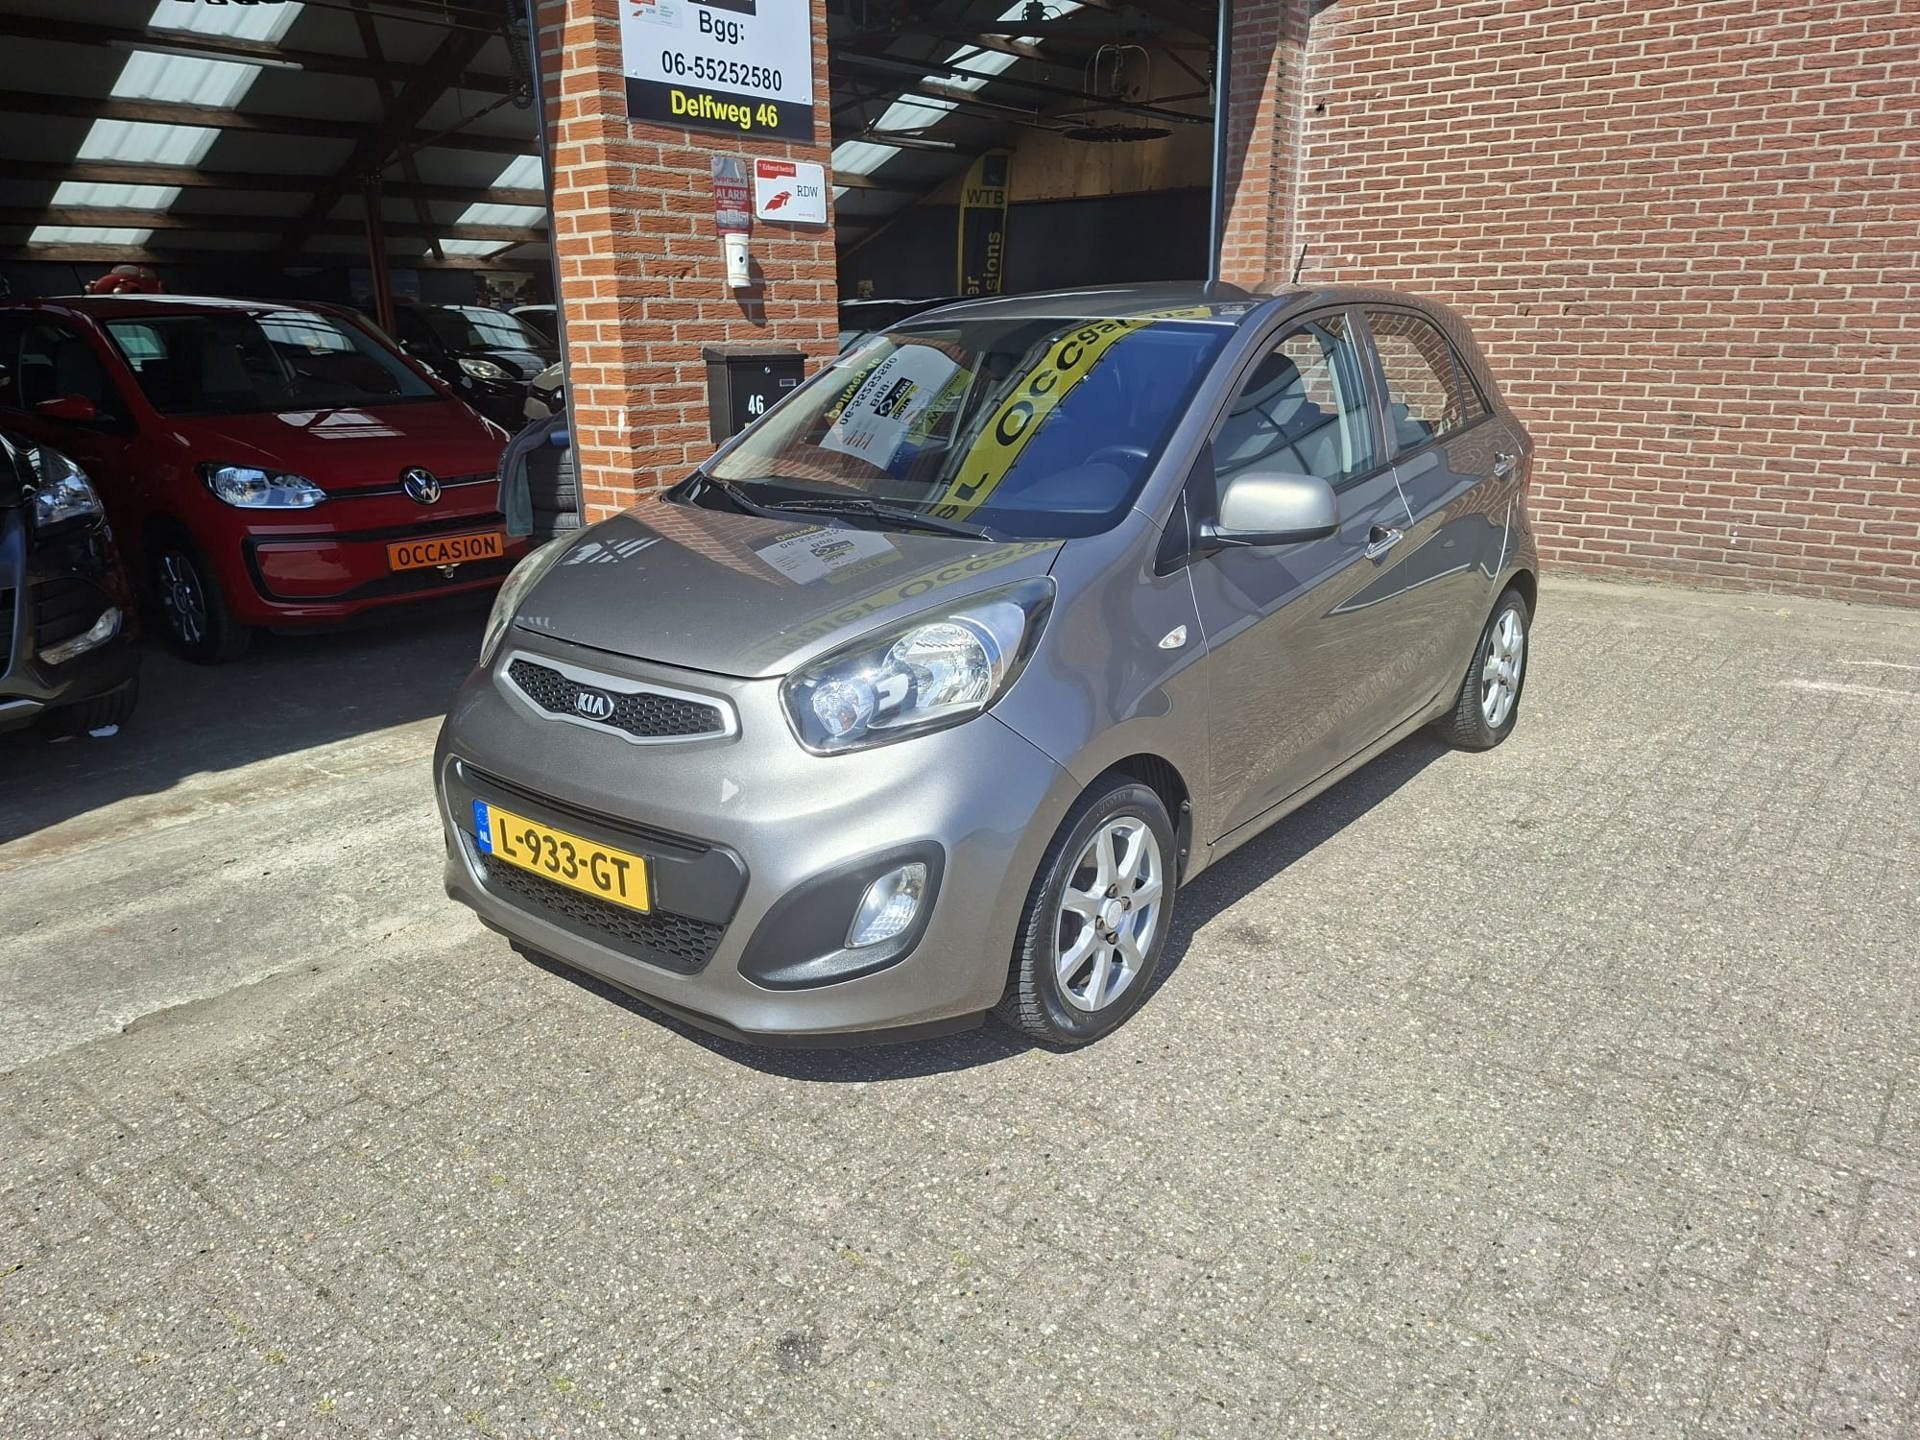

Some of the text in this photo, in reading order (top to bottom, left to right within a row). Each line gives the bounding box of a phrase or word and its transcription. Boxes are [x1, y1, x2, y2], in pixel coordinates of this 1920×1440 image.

[698, 10, 745, 44] Bgg:
[661, 50, 782, 91] 06-55252580
[671, 90, 779, 130] Delfweg 46
[716, 188, 747, 200] ALARM
[797, 185, 818, 198] RDW
[967, 187, 1004, 205] WTB
[982, 231, 1001, 294] sions
[747, 394, 764, 415] 46
[397, 536, 497, 566] OCCASION
[577, 692, 604, 715] KIA
[479, 818, 630, 897] NL L-933-GT
